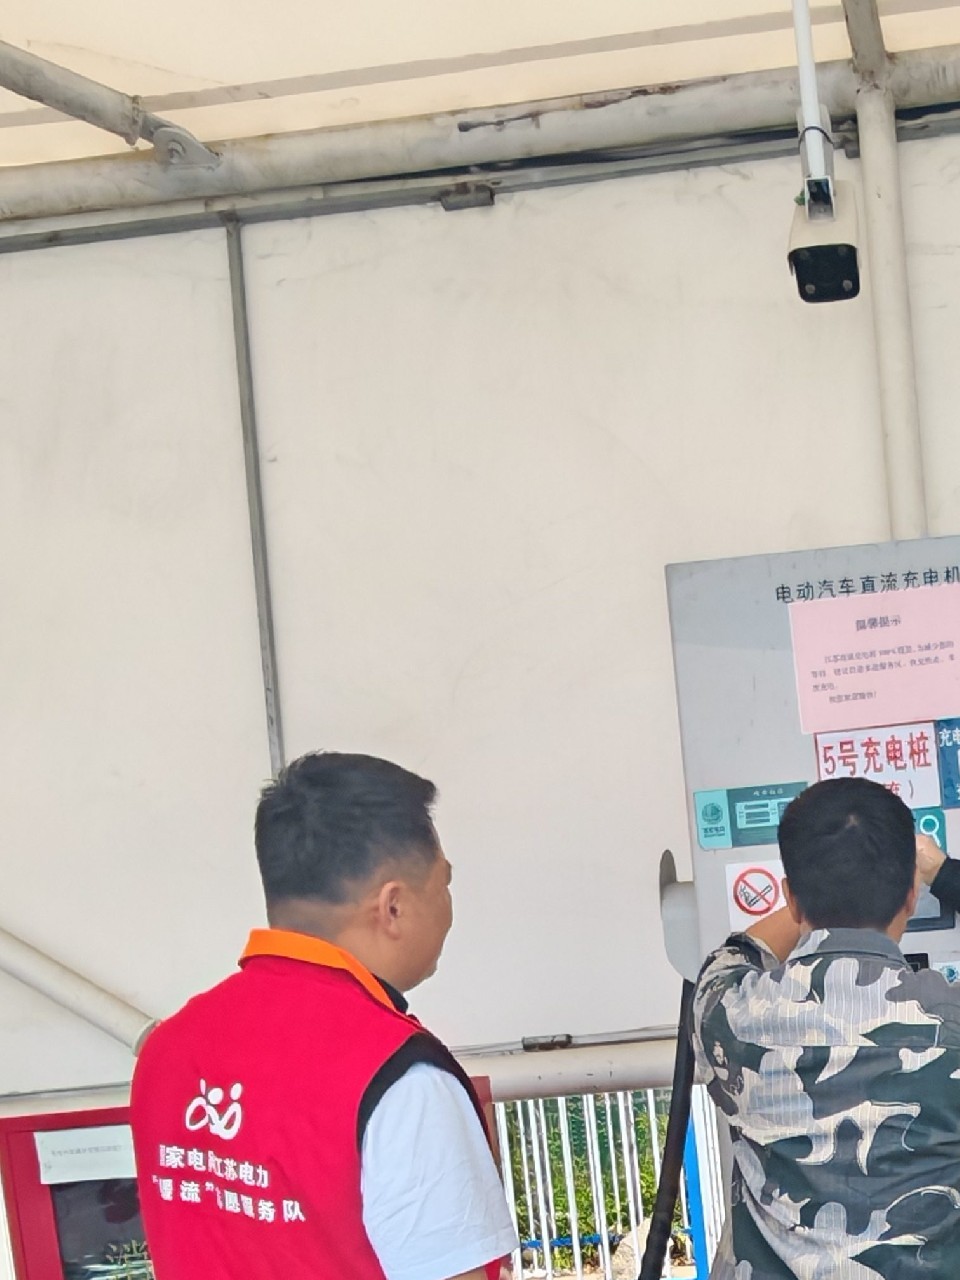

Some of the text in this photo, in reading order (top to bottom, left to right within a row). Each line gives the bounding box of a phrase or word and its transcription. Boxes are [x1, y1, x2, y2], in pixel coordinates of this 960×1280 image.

[775, 565, 960, 604] 电动汽车直流充电机
[823, 731, 932, 776] 5号充电桩
